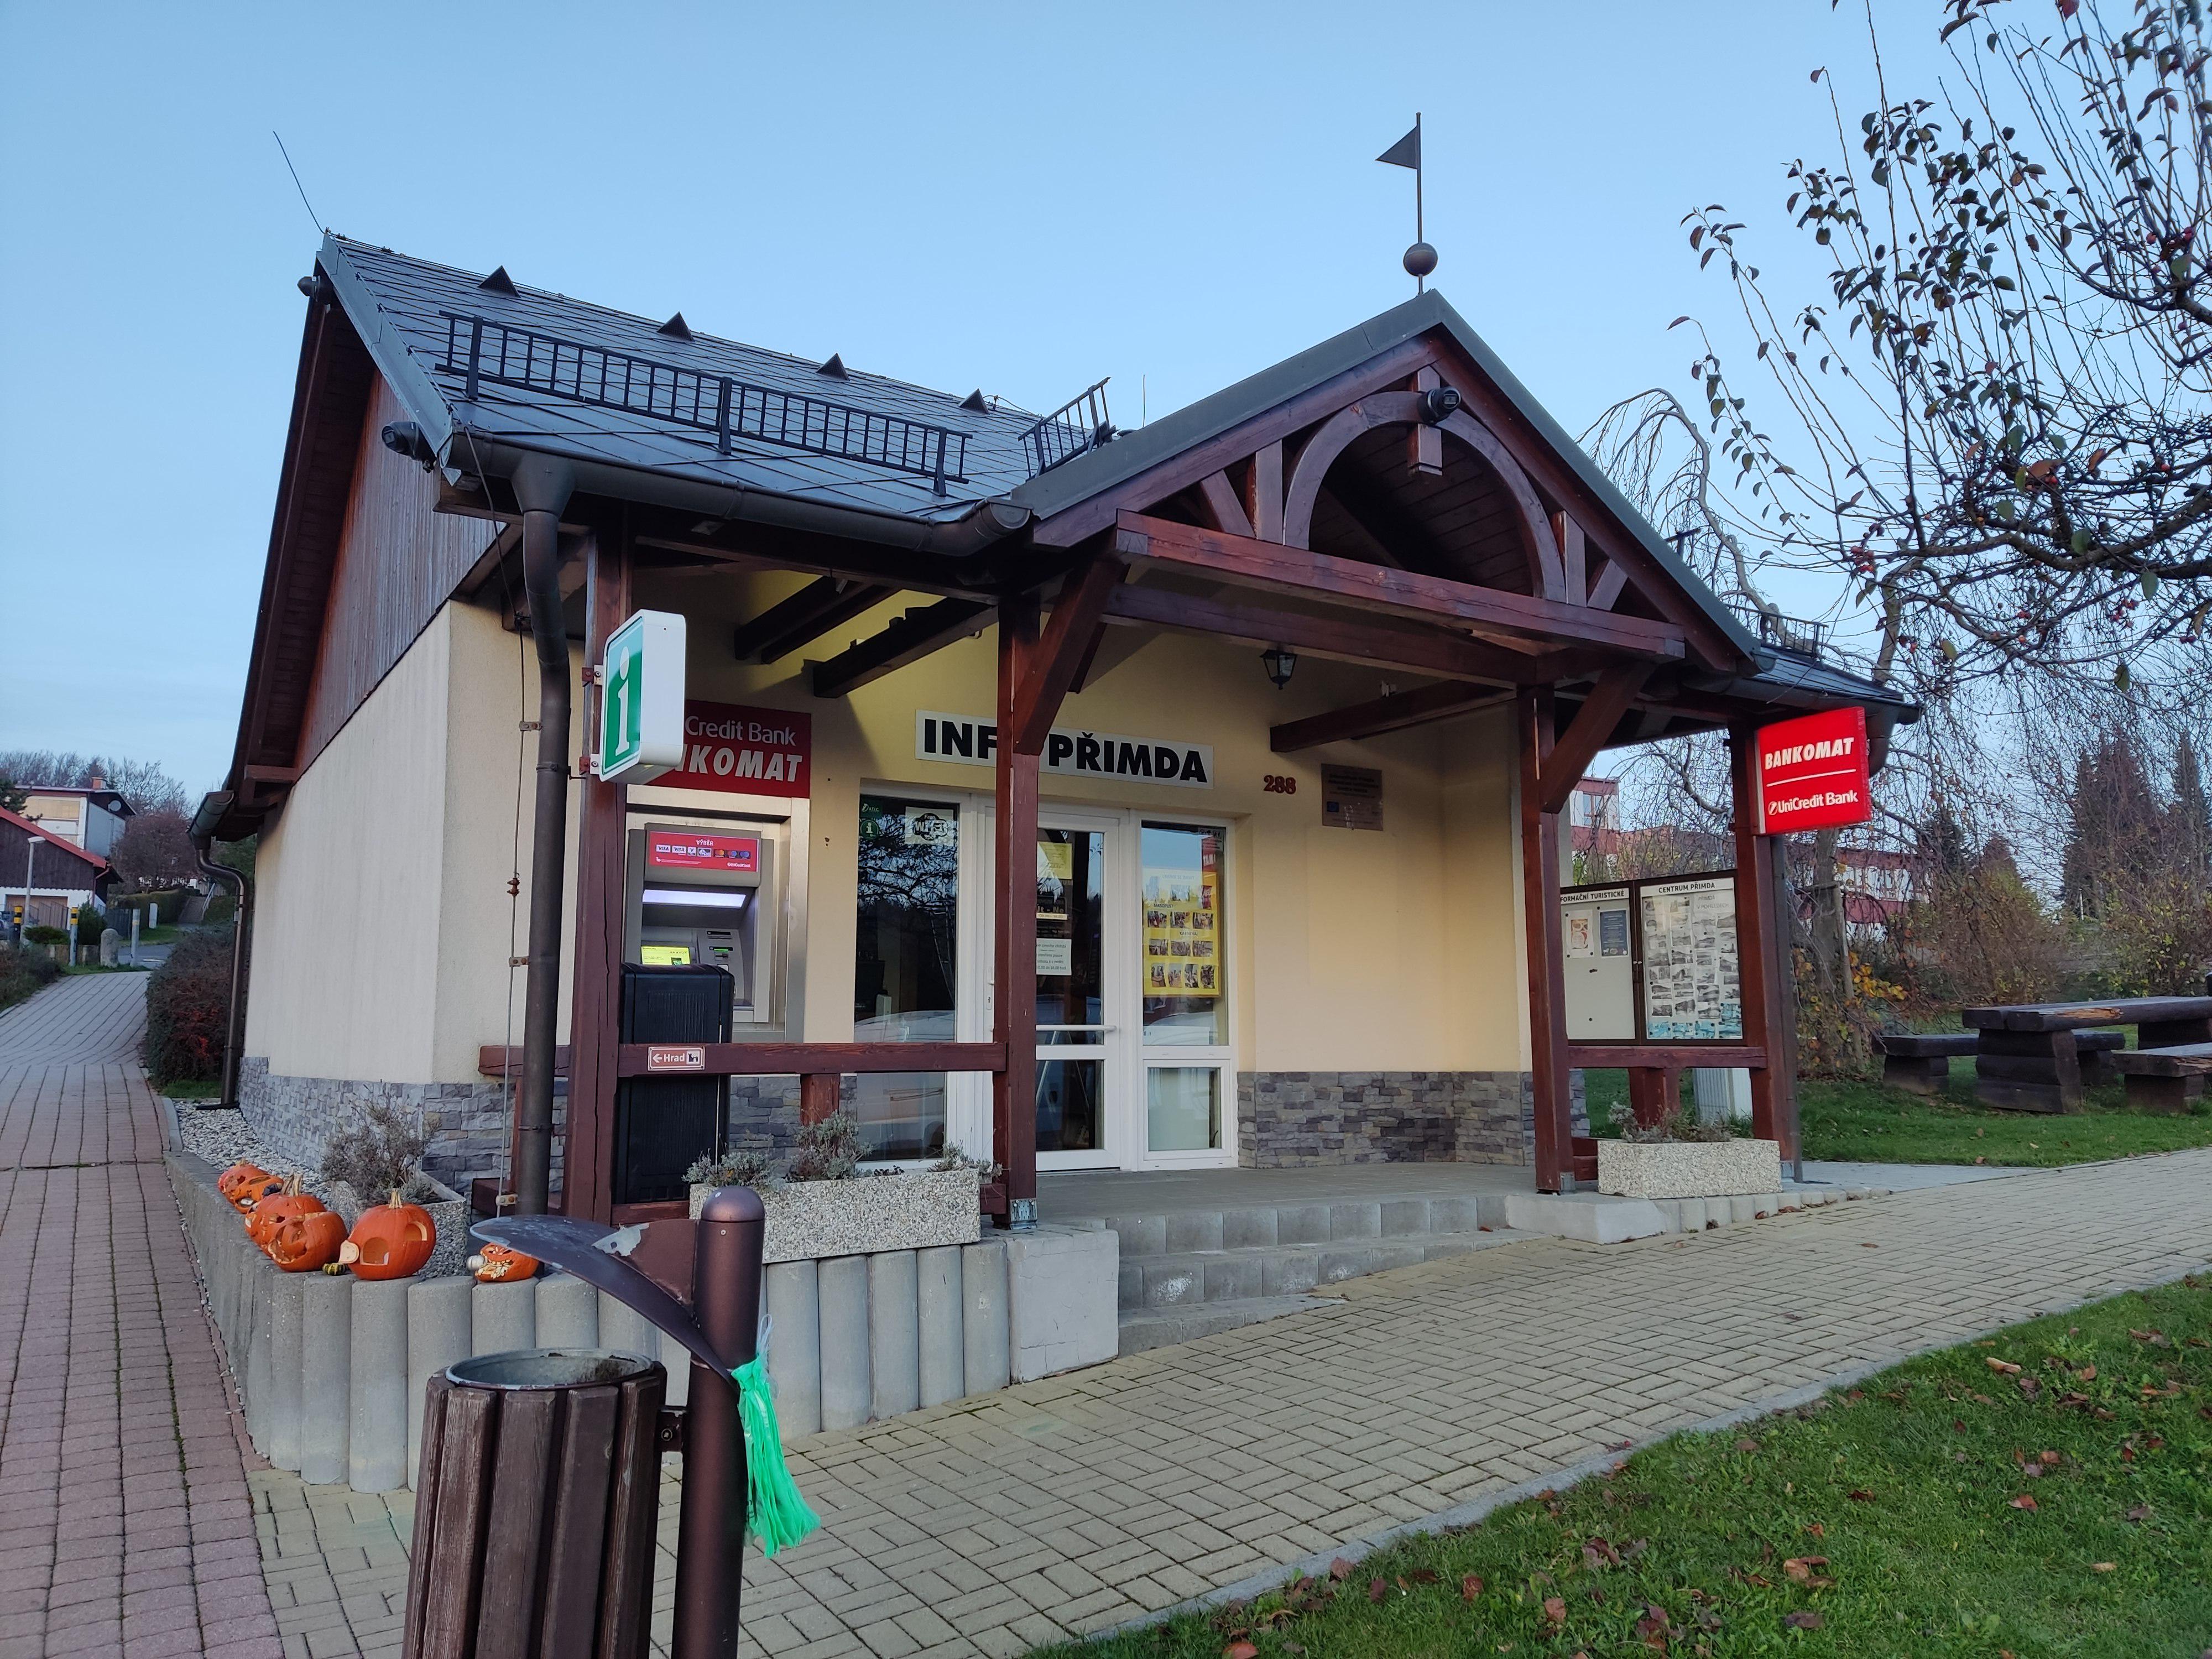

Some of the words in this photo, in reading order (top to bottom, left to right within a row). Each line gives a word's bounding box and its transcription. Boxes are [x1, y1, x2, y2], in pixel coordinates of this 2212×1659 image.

[685, 716, 743, 740] Credit
[748, 722, 796, 747] Bank
[924, 718, 998, 759] INF
[1048, 732, 1208, 784] PŘIMDA
[1765, 737, 1854, 770] BANKOMAT
[675, 744, 803, 782] KOMAT
[1264, 775, 1296, 795] 288
[1777, 794, 1824, 813] UniCredit
[1825, 790, 1859, 805] Bank
[1560, 893, 1589, 902] FORMAČNÍ
[1590, 889, 1625, 899] TURISTICKÉ
[1658, 884, 1688, 893] CENTRUM
[1691, 882, 1715, 891] PŘIMDA
[664, 1053, 685, 1062] Hrad
